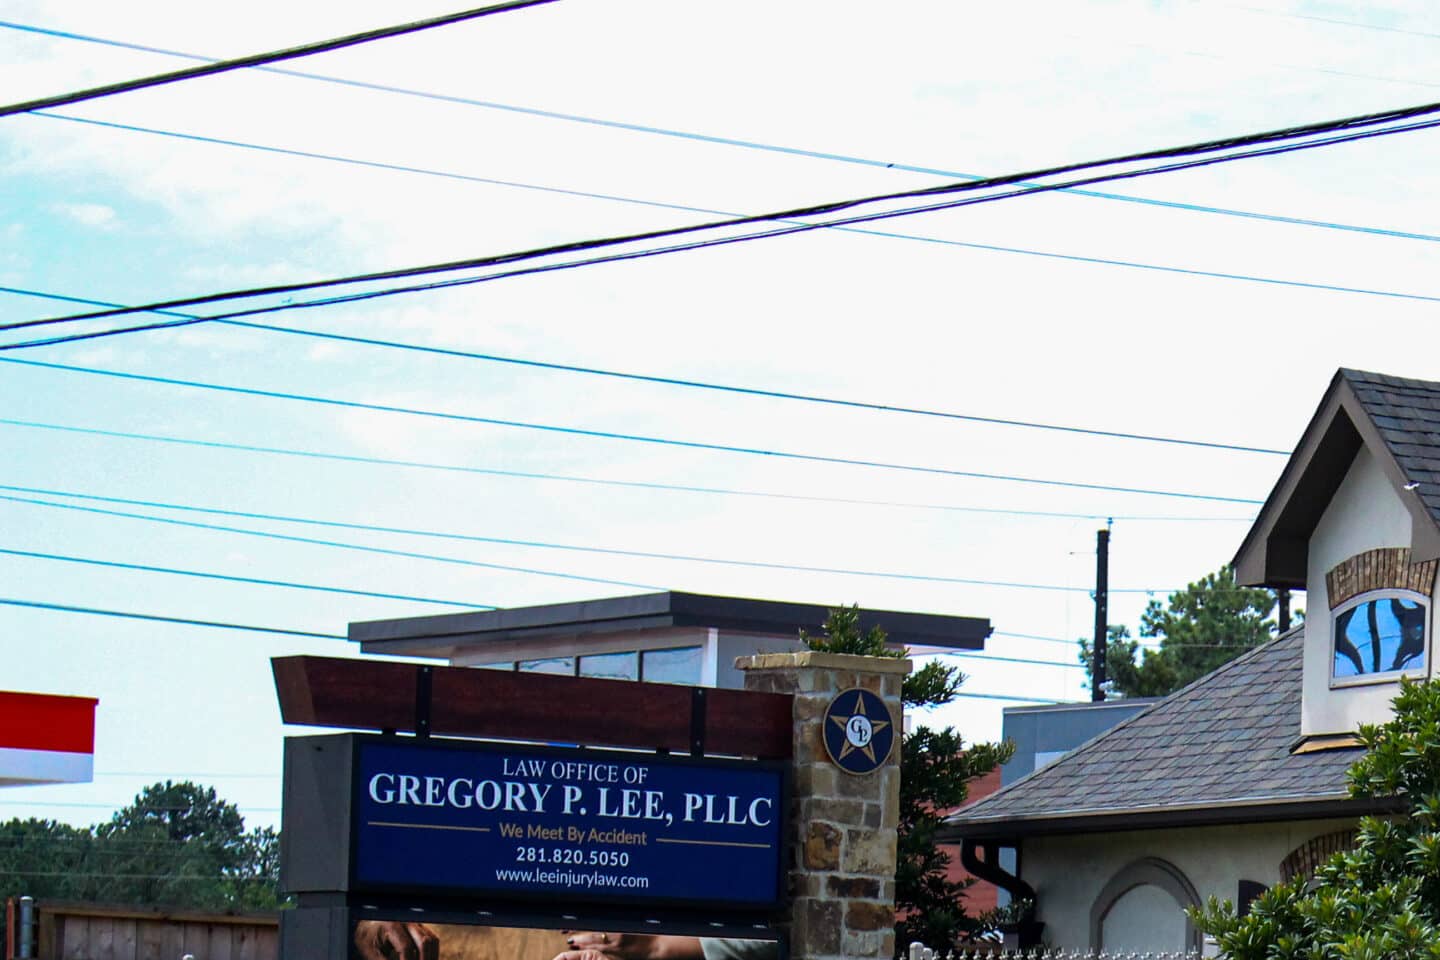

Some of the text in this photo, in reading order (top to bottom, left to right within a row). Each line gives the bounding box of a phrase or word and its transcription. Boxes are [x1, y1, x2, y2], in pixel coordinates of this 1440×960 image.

[503, 758, 649, 784] LAW OFFICE OF
[368, 773, 772, 827] GREGORY P. LEE, PLLC
[499, 822, 647, 846] We Meet By Accident
[516, 846, 629, 867] 281.820.5050
[496, 867, 649, 889] www.leeinjurylaw.com
